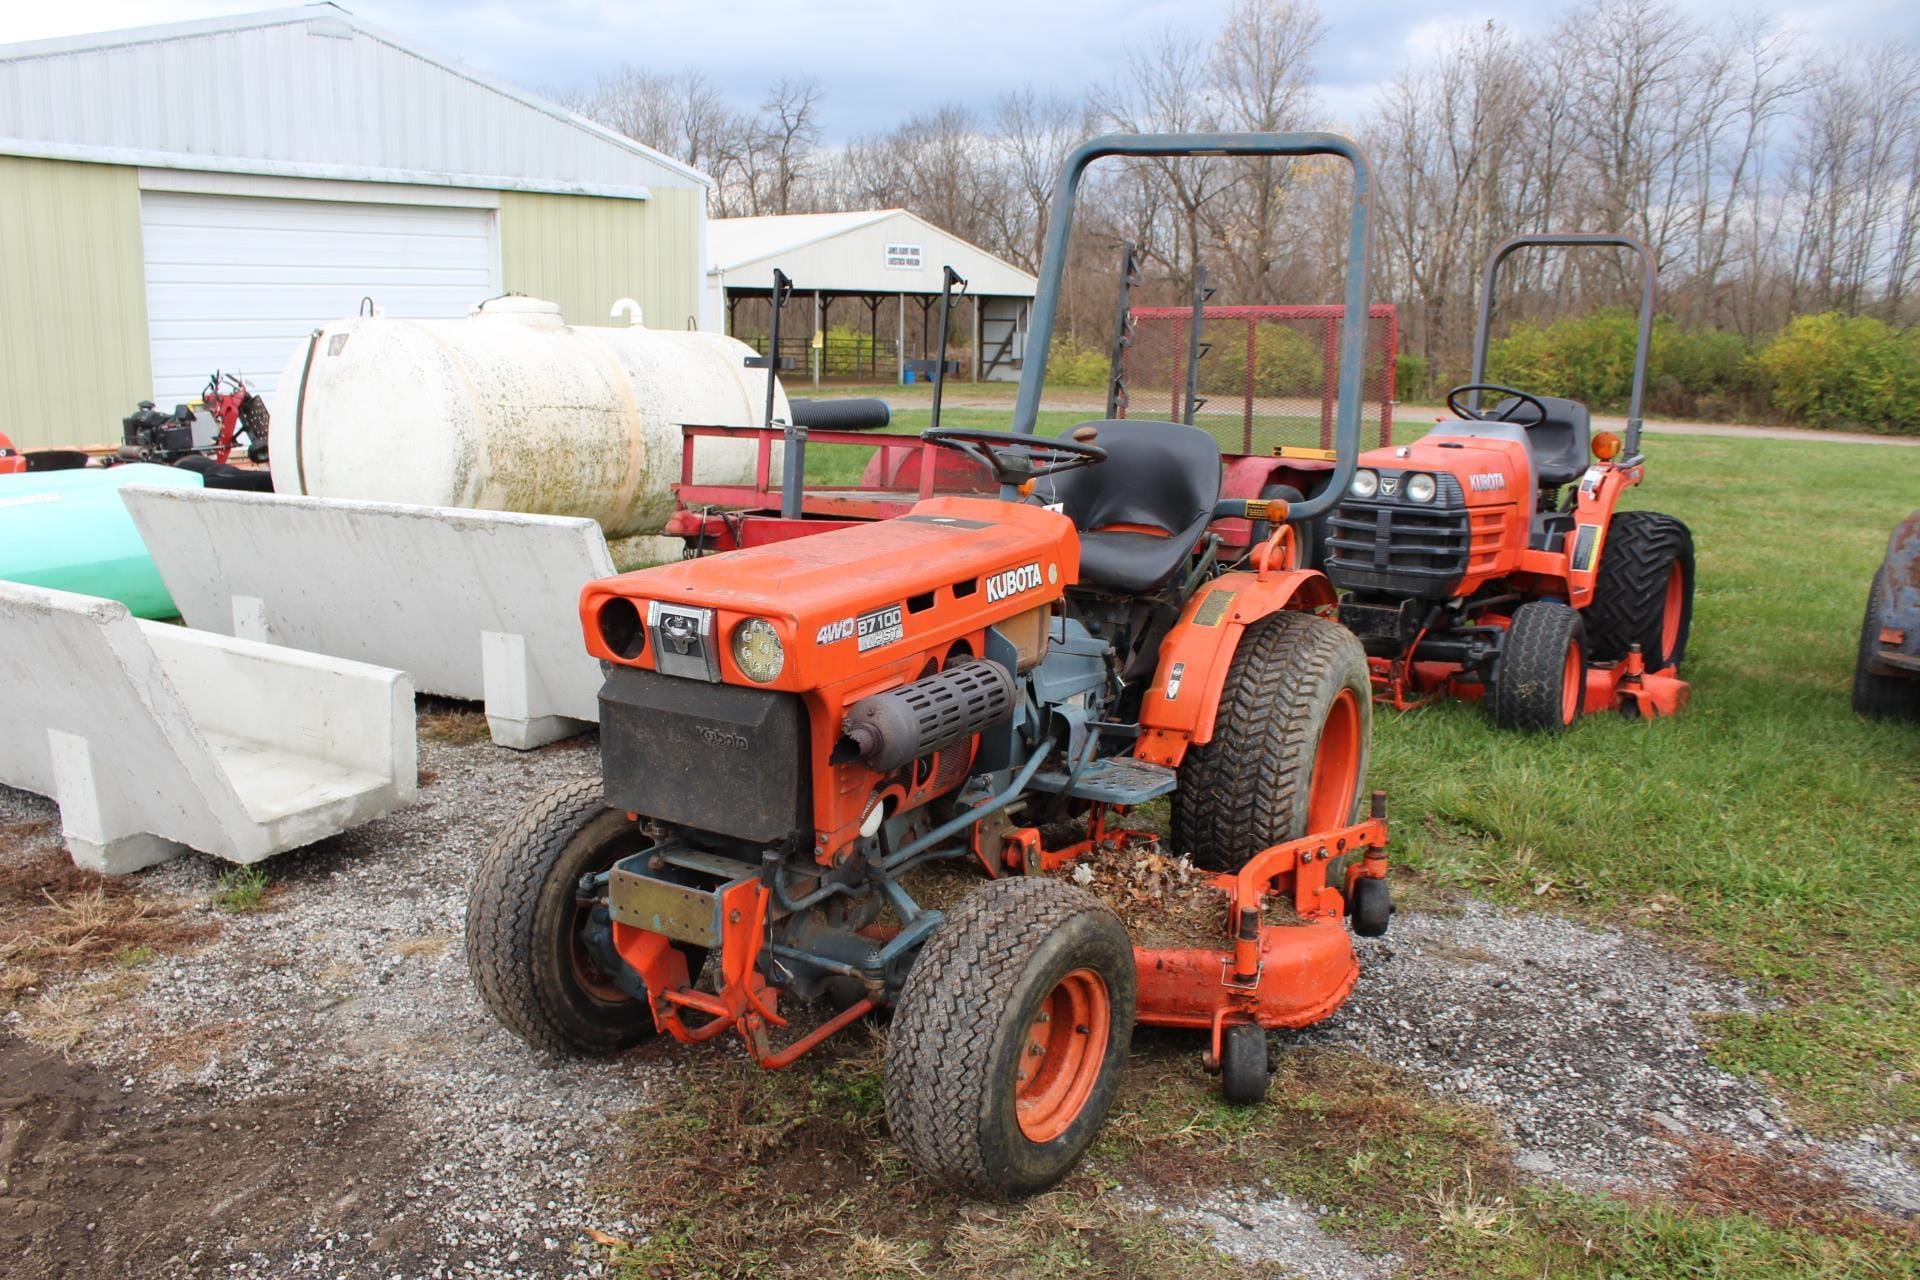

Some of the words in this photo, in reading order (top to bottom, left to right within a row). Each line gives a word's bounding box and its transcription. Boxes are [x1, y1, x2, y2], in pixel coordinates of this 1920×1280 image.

[1468, 472, 1506, 492] KUBOTA
[986, 562, 1043, 604] KUBOTA
[816, 617, 855, 645] 4WD
[857, 608, 902, 637] B7100
[875, 625, 900, 646] HST
[696, 725, 749, 751] Kubota
